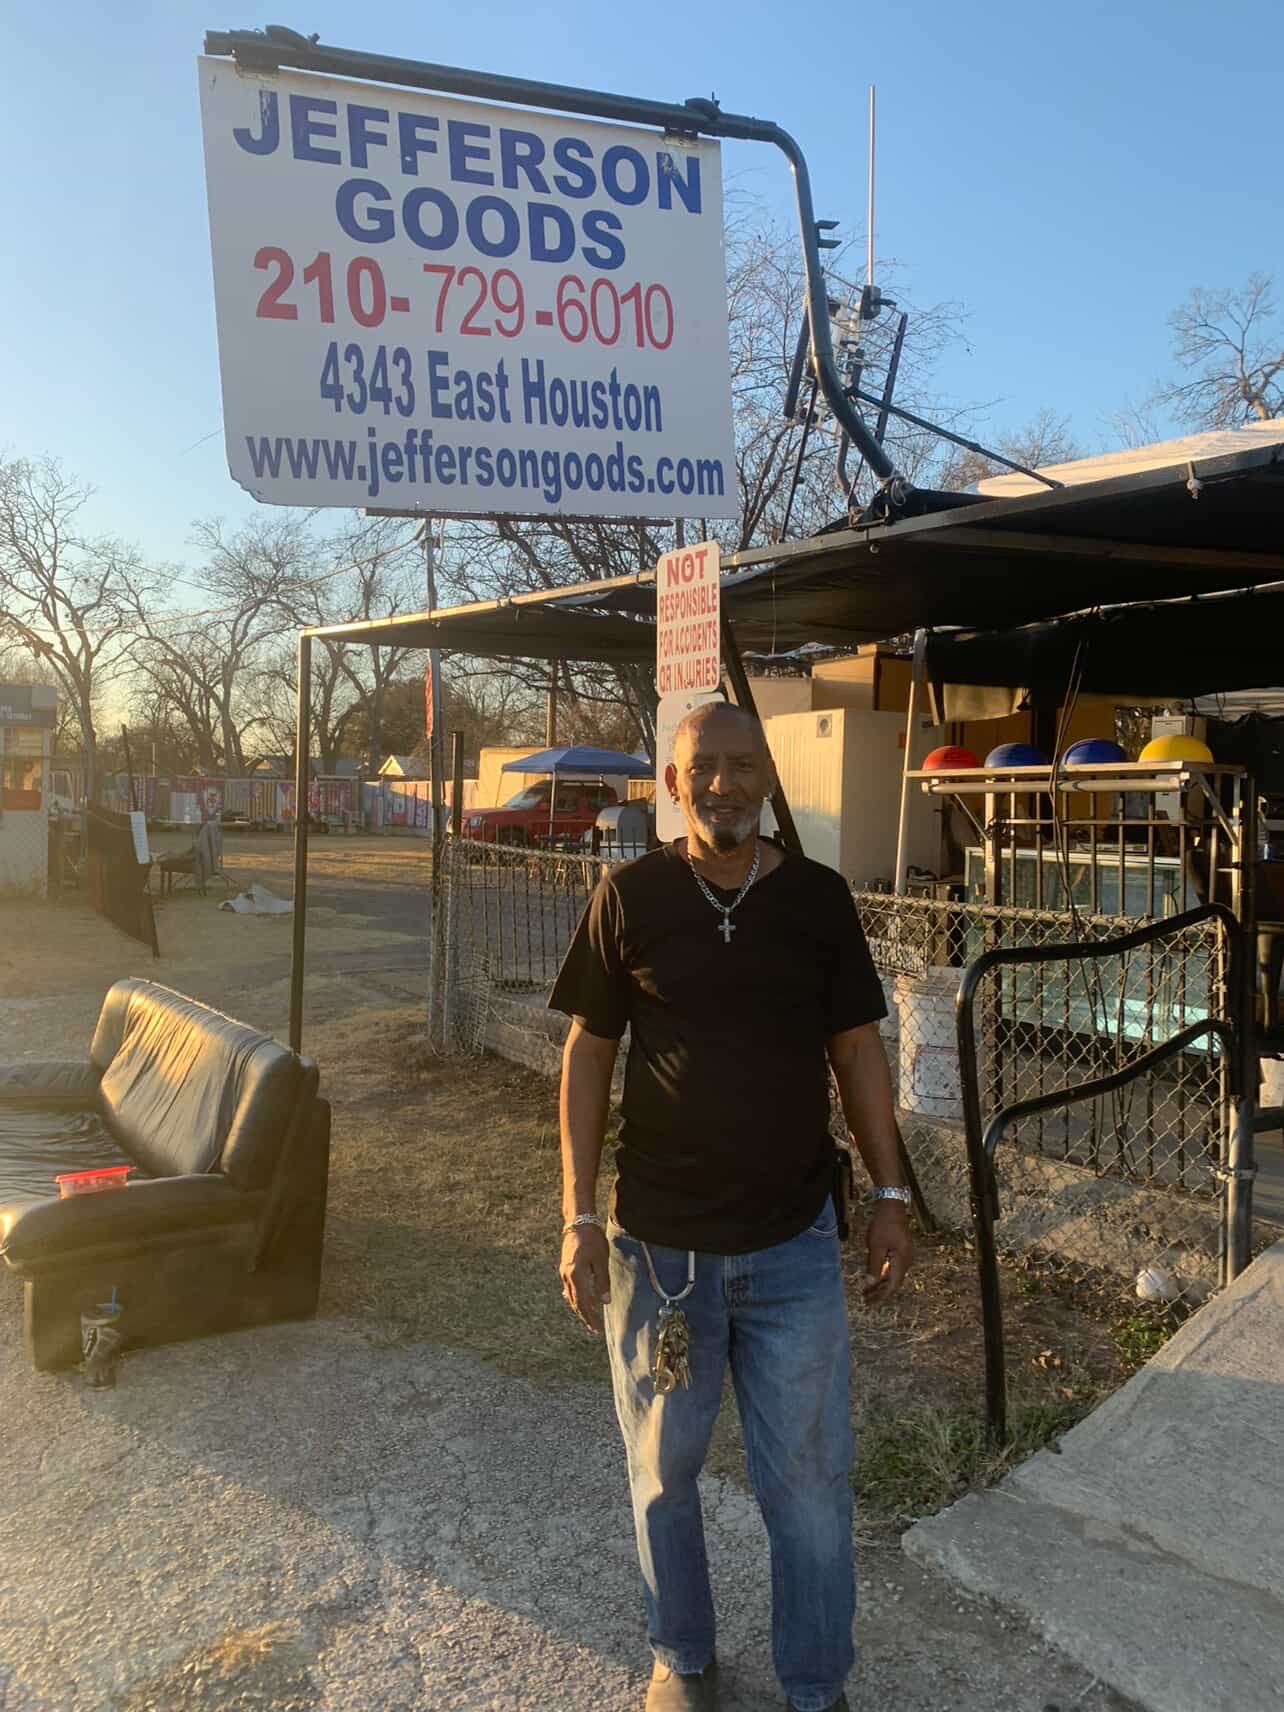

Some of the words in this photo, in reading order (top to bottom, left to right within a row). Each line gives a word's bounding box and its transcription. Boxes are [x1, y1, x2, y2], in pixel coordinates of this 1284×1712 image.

[233, 89, 702, 214] JEFFERSON
[336, 178, 625, 270] GOODS
[320, 341, 415, 417] 4343
[428, 350, 511, 425] East
[521, 357, 662, 432] Houston
[246, 426, 724, 504] www.jeffersongoods.com
[667, 549, 708, 587] NOT
[659, 583, 717, 624] RESPONSIBLE
[659, 629, 673, 658] FOR
[675, 620, 717, 656] ACCIDENTS
[659, 664, 671, 692] OR
[674, 656, 717, 690] INJURIES
